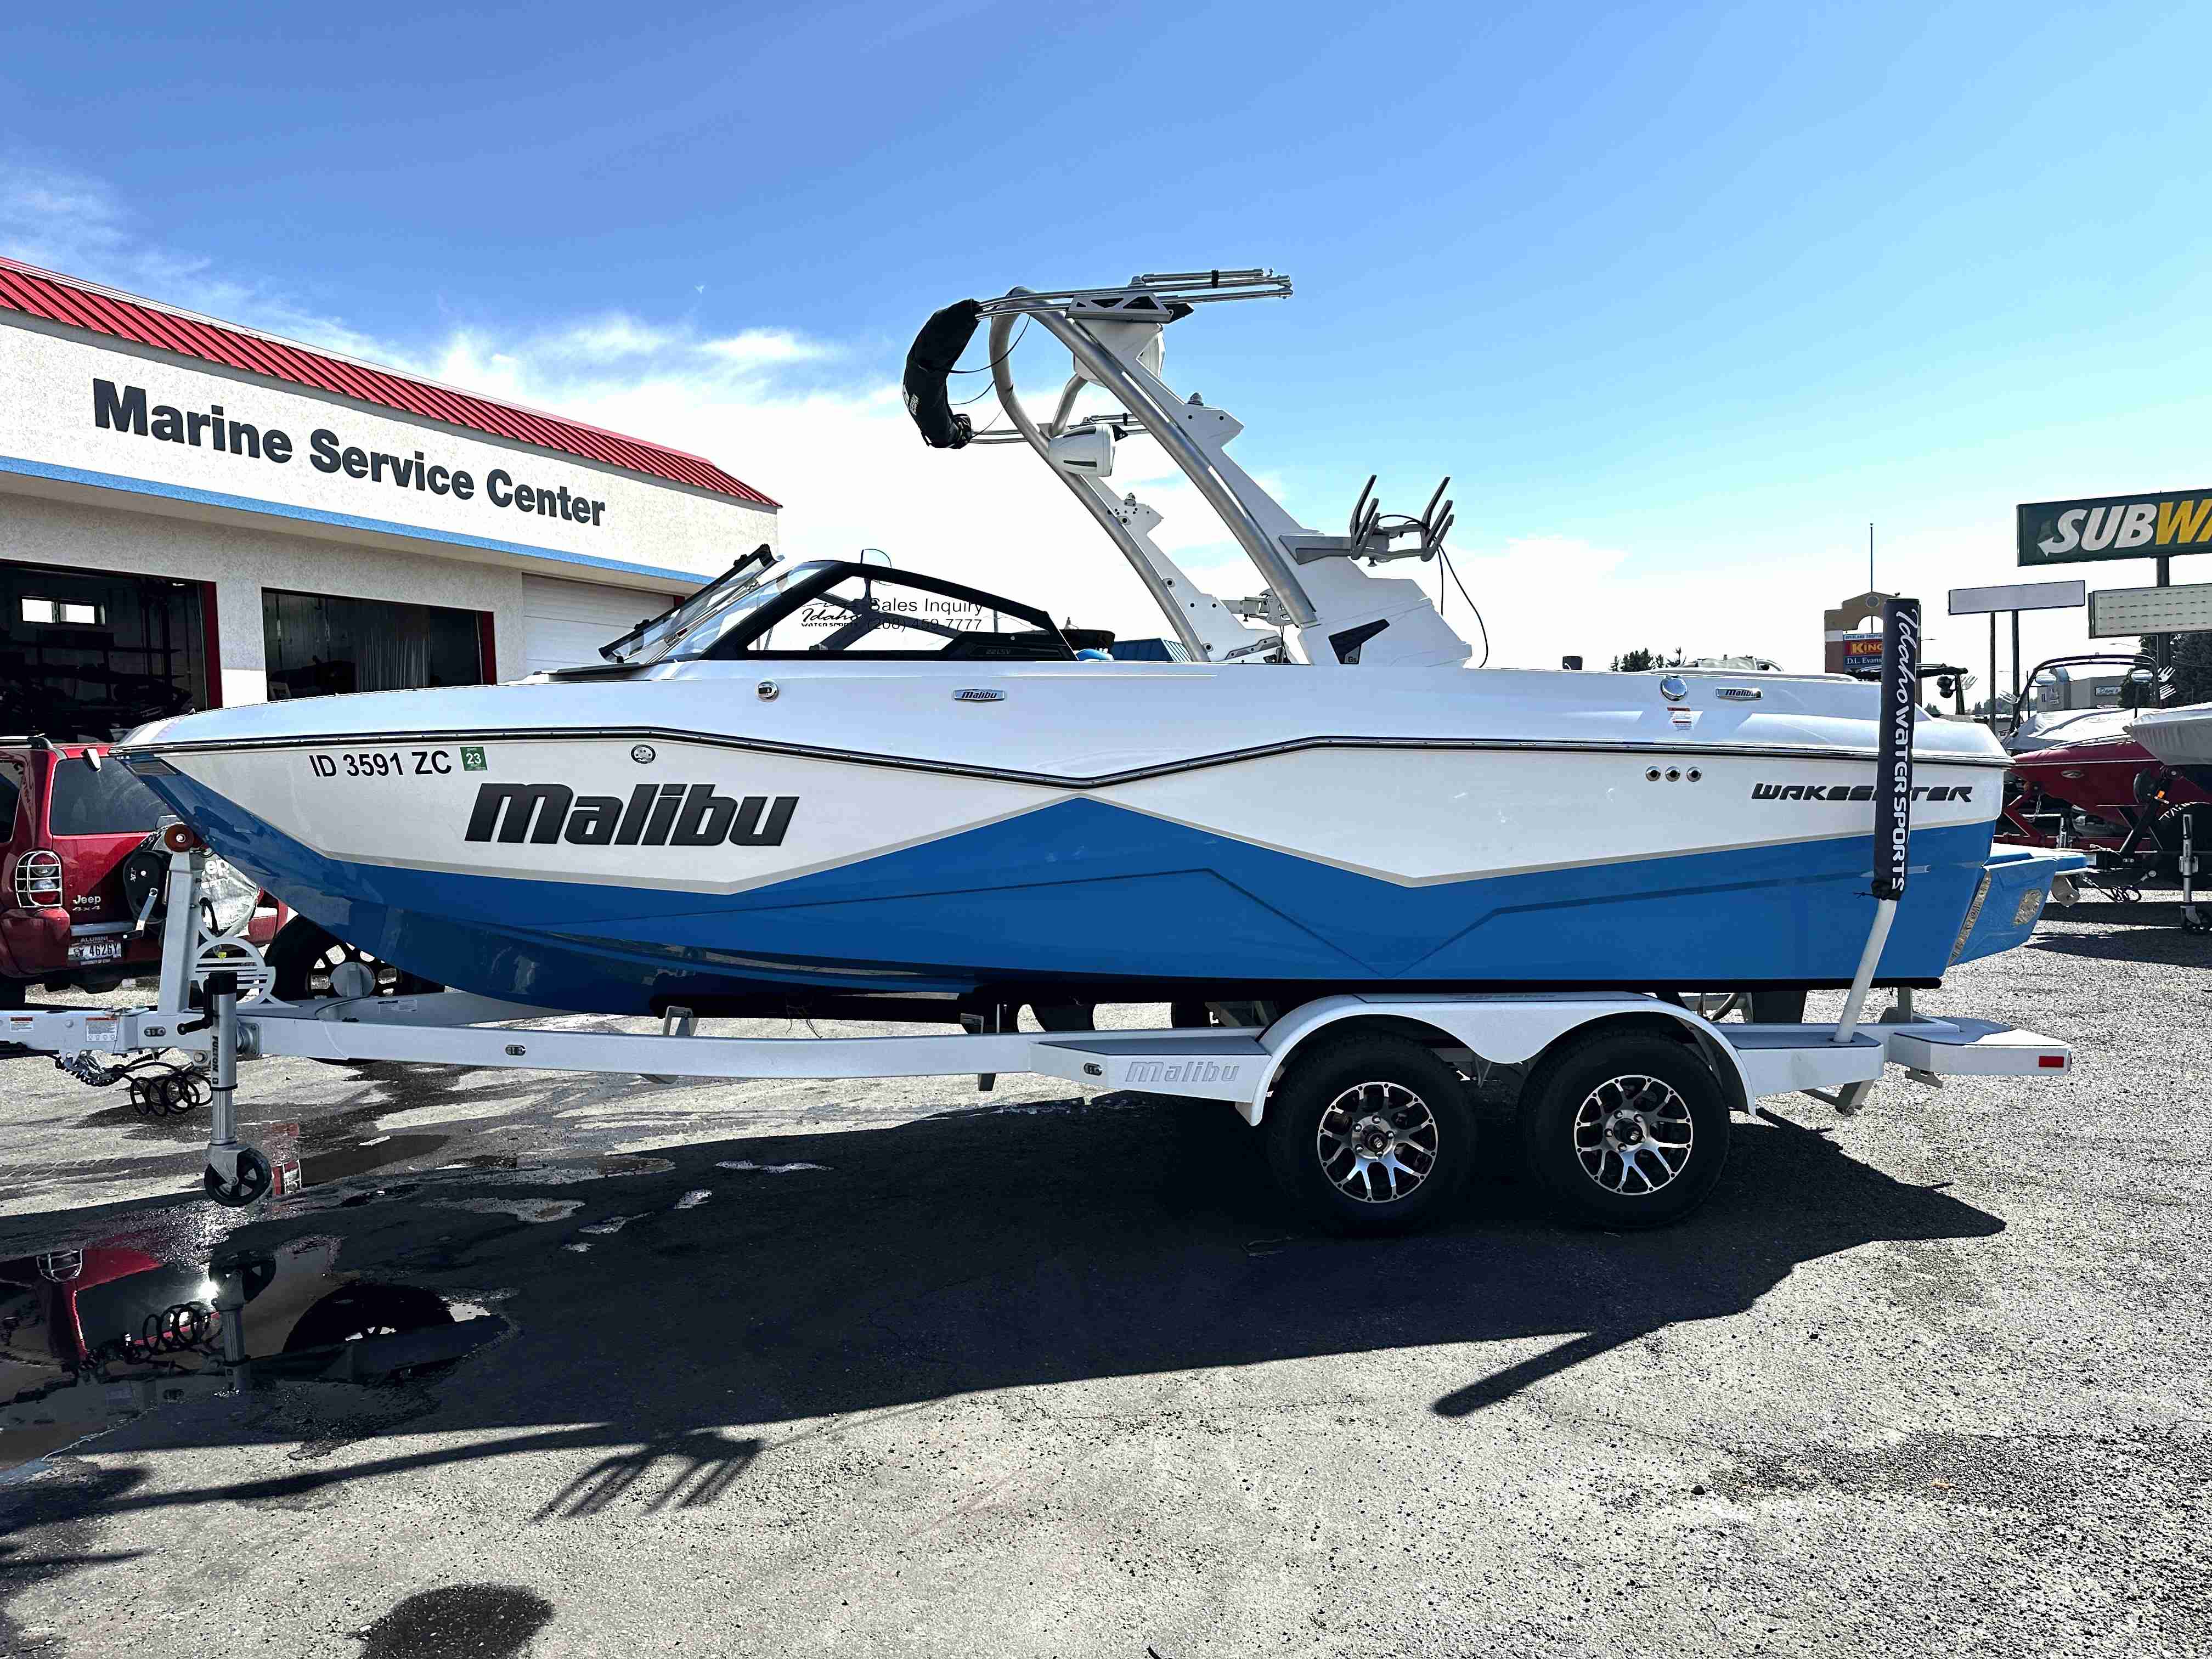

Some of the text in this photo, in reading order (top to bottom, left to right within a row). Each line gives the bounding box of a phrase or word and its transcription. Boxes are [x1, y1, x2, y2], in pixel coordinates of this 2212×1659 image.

[93, 378, 606, 526] Marine Service Center
[802, 608, 859, 622] Idaho
[869, 597, 982, 616] Sales Inquiry
[1896, 609, 1918, 703] Idaho
[309, 750, 452, 777] ID 3591 ZC
[466, 753, 482, 764] 23
[464, 783, 800, 847] Malibu
[72, 895, 101, 905] Jeep
[89, 943, 118, 956] 4626Y
[1125, 1062, 1240, 1082] Malibu
